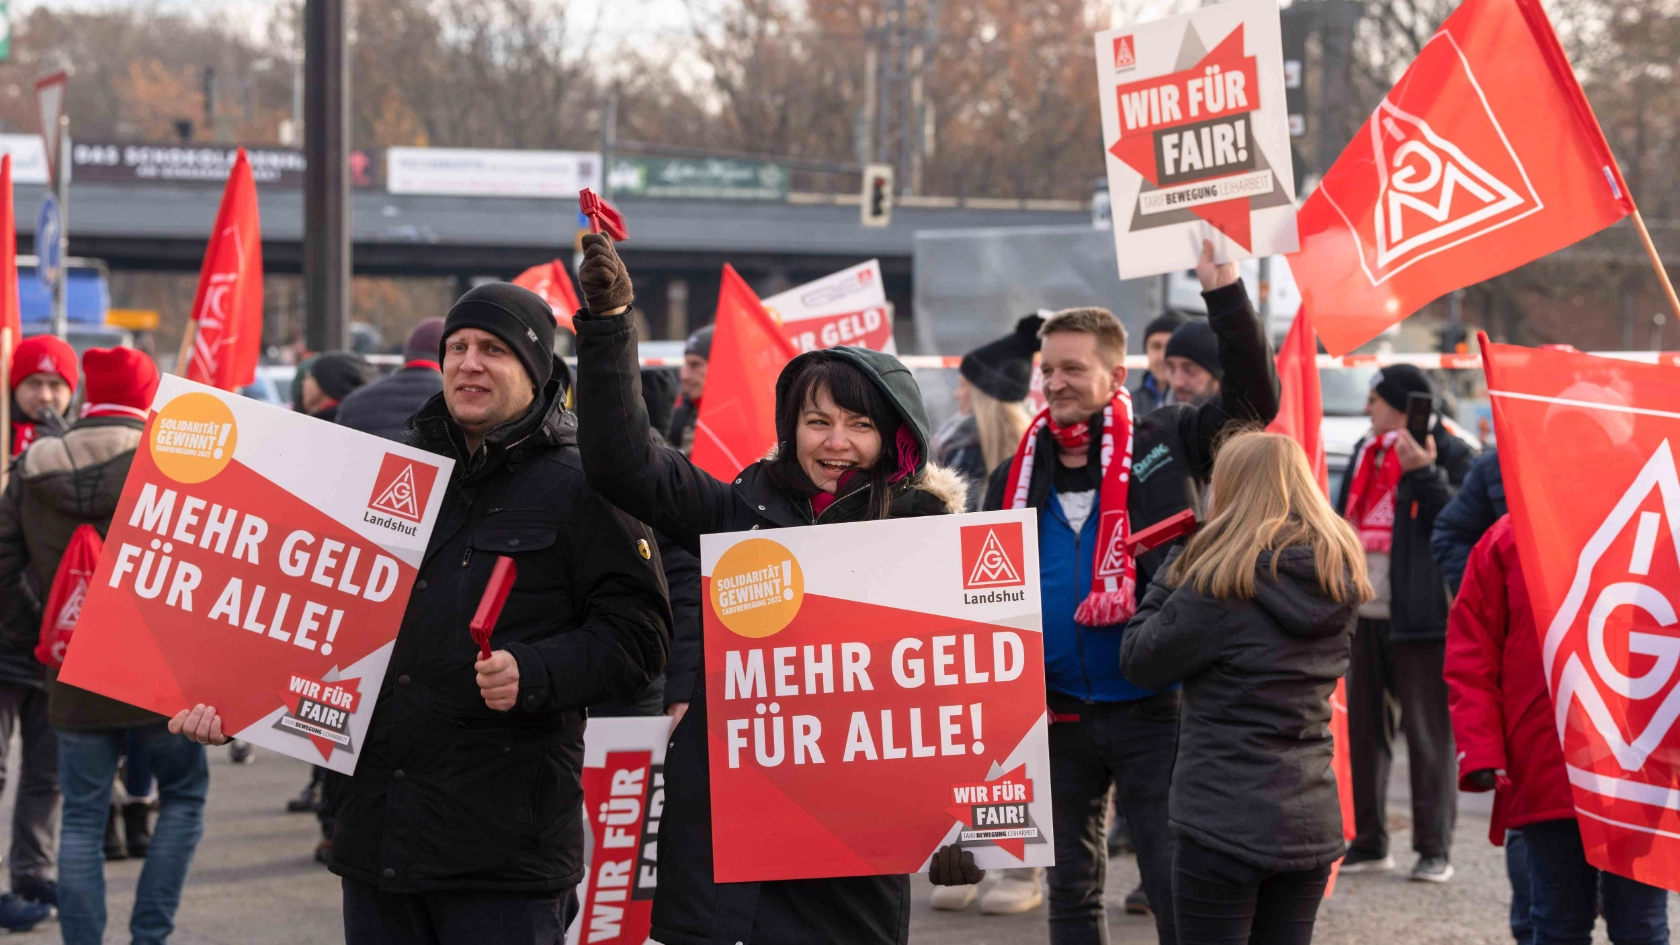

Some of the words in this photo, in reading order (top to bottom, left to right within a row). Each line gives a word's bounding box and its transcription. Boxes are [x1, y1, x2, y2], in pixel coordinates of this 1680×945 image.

[1121, 84, 1182, 130] WIR
[1187, 65, 1248, 117] FÜR
[74, 145, 119, 165] DAS
[1162, 119, 1248, 176] FAIR!
[821, 309, 881, 347] GELD
[160, 418, 220, 435] SOLIDARITÄT
[363, 511, 418, 537] Landshut
[128, 483, 268, 565] MEHR
[279, 530, 399, 603] GELD
[717, 564, 780, 591] SOLIDARITÄT
[108, 538, 202, 612] FÜR
[208, 577, 344, 656] ALLE!
[722, 599, 766, 616] TARIFBEWEGUNG
[767, 596, 782, 605] 2022
[964, 590, 1025, 604] Landshut
[724, 641, 874, 700] MEHR
[891, 631, 1025, 689] GELD
[289, 675, 320, 699] WIR
[322, 686, 353, 709] FÜR
[300, 700, 346, 728] FAIR!
[727, 702, 825, 768] FÜR
[843, 703, 985, 762] ALLE!
[598, 767, 646, 848] FÜR
[953, 786, 988, 804] WIR
[992, 780, 1026, 801] FÜR
[976, 805, 1025, 825] FAIR!
[587, 859, 632, 944] WIR
